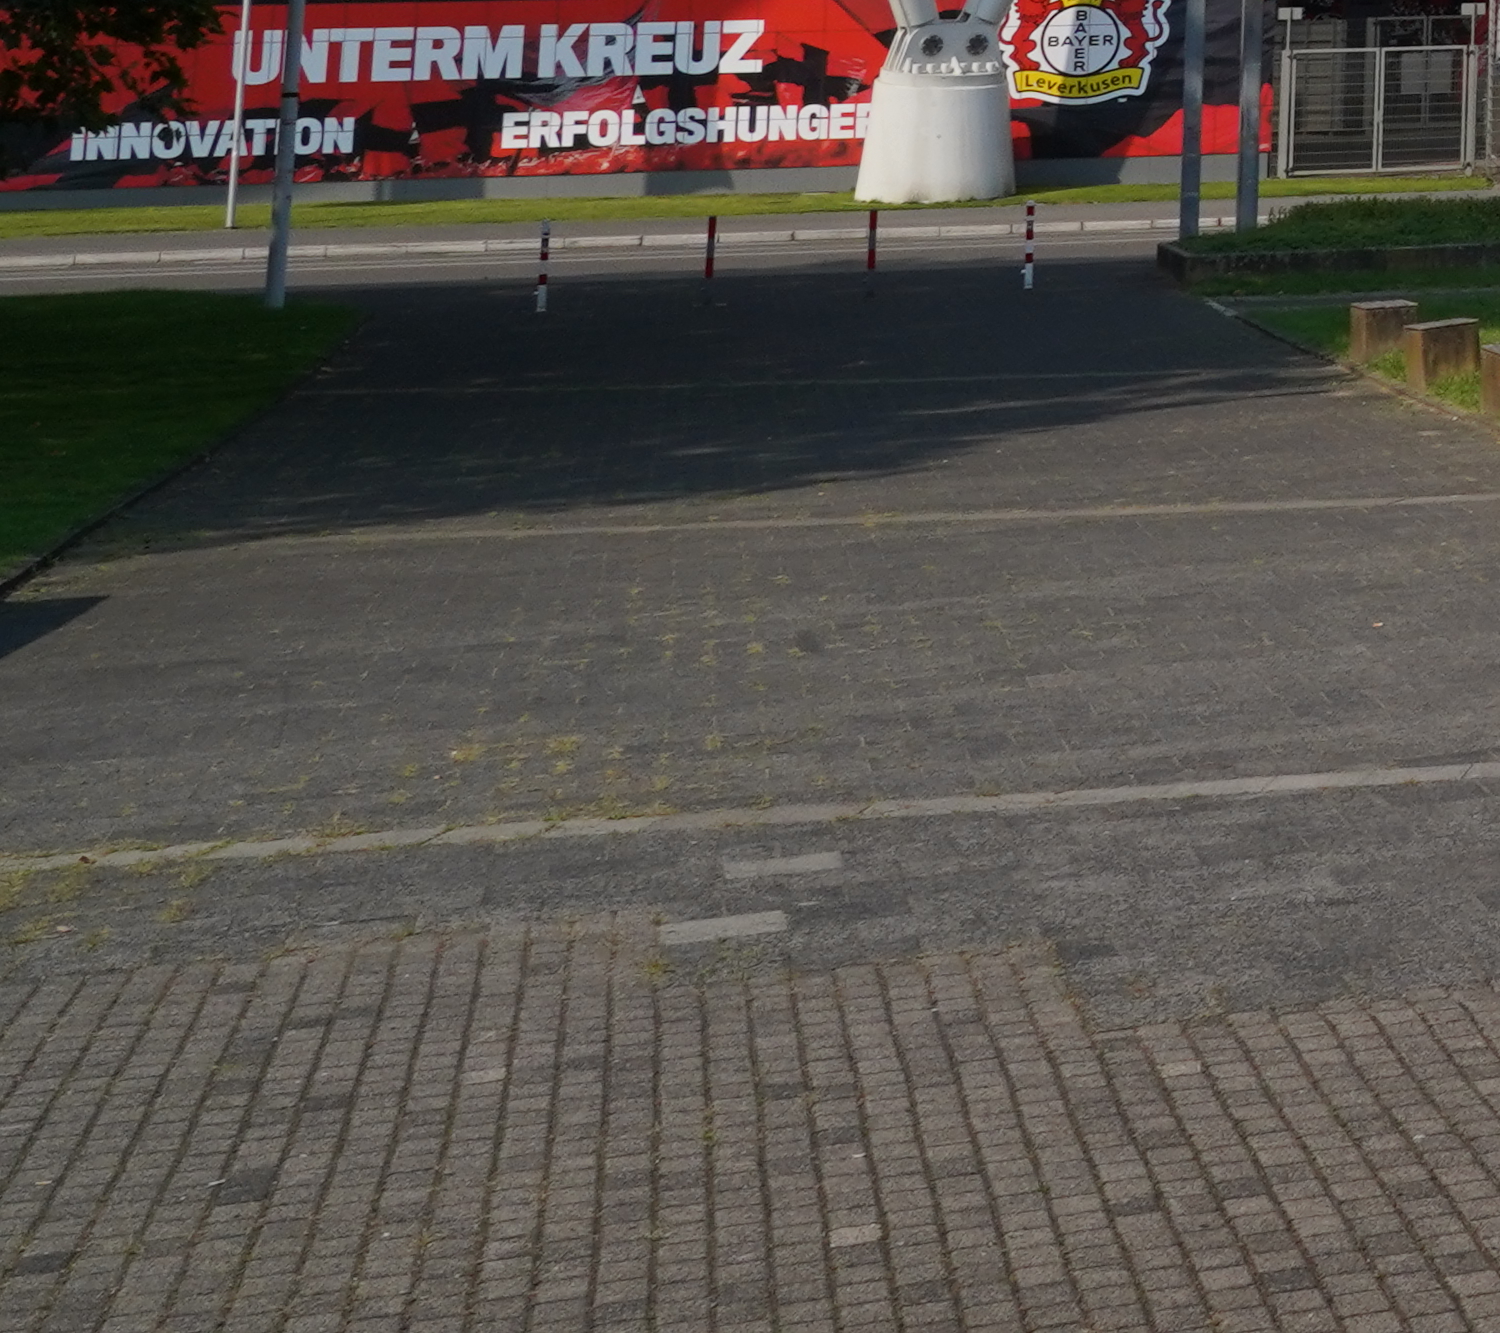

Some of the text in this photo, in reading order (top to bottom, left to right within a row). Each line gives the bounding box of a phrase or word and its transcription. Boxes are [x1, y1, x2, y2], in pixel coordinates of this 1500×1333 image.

[537, 18, 765, 78] KREUZ
[1048, 35, 1113, 46] BAYER
[1074, 10, 1087, 71] BAYER
[1025, 73, 1132, 94] Leverkusen
